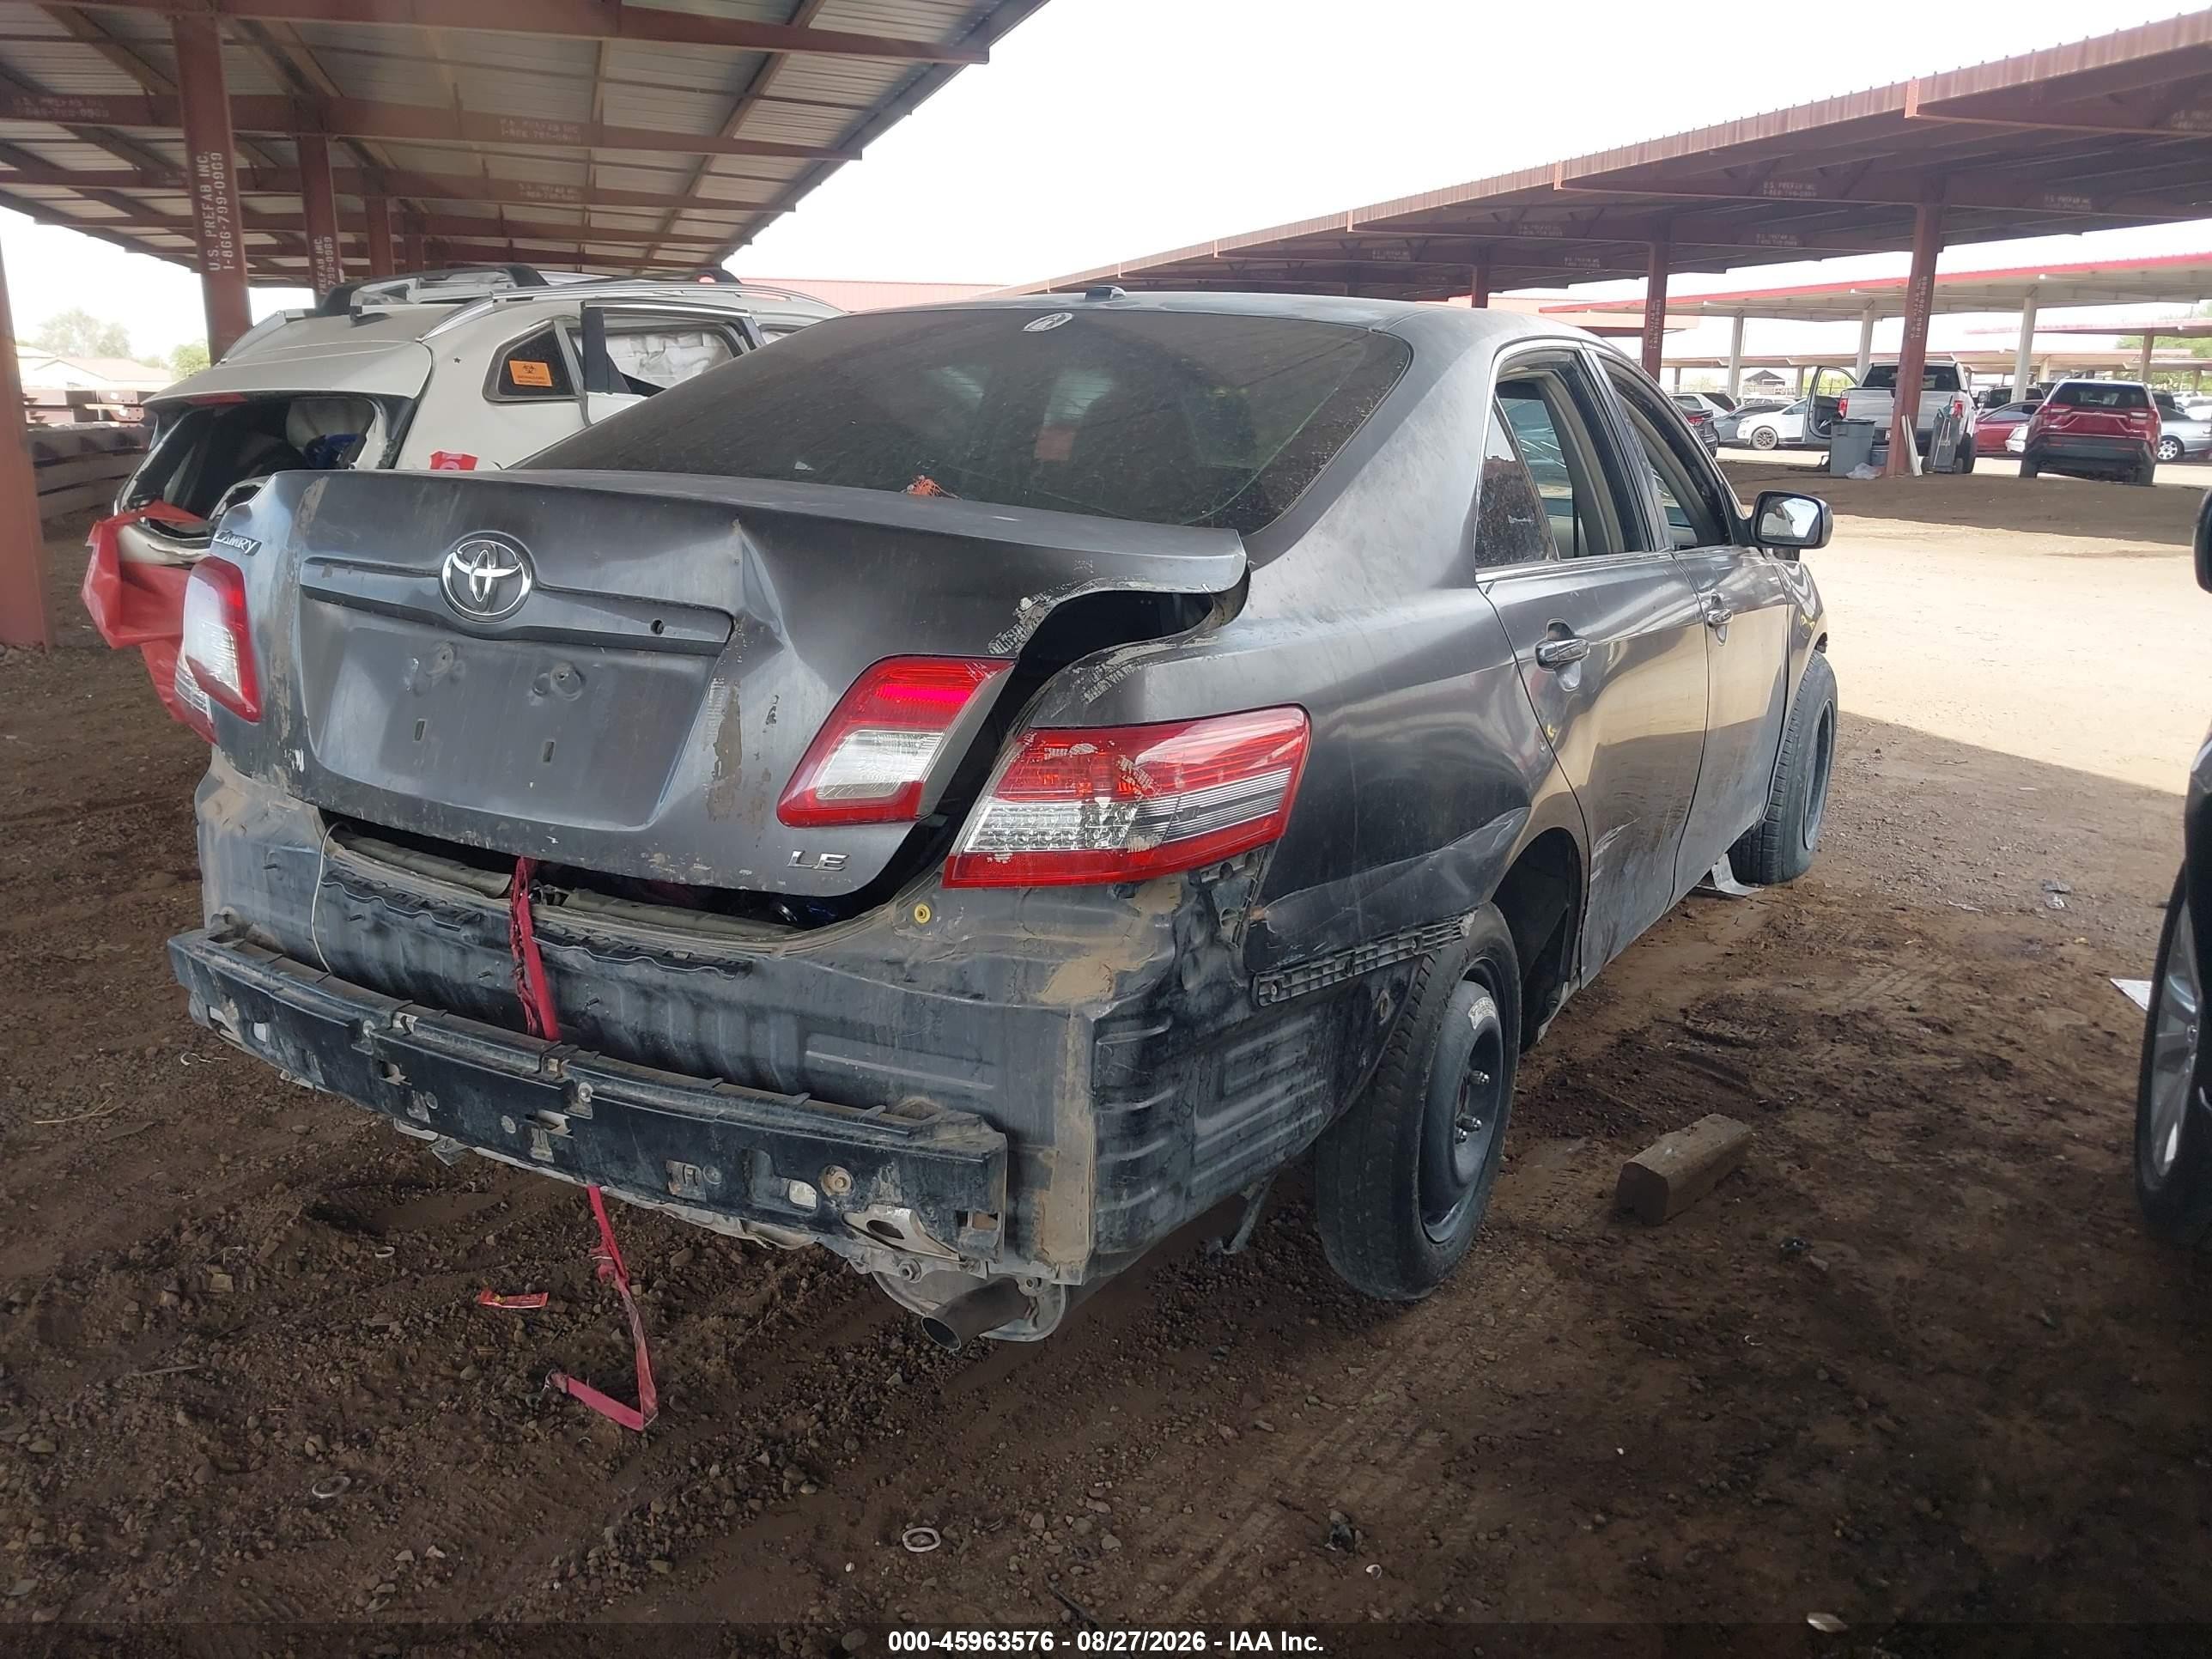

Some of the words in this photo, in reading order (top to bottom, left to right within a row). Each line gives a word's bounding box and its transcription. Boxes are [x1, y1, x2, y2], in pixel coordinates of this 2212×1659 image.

[196, 151, 210, 178] INC.
[199, 185, 217, 238] PREFAB
[210, 152, 235, 270] 1-866-799-0969
[207, 245, 220, 271] U.S.
[212, 529, 259, 554] CAMRY
[786, 849, 850, 872] LE
